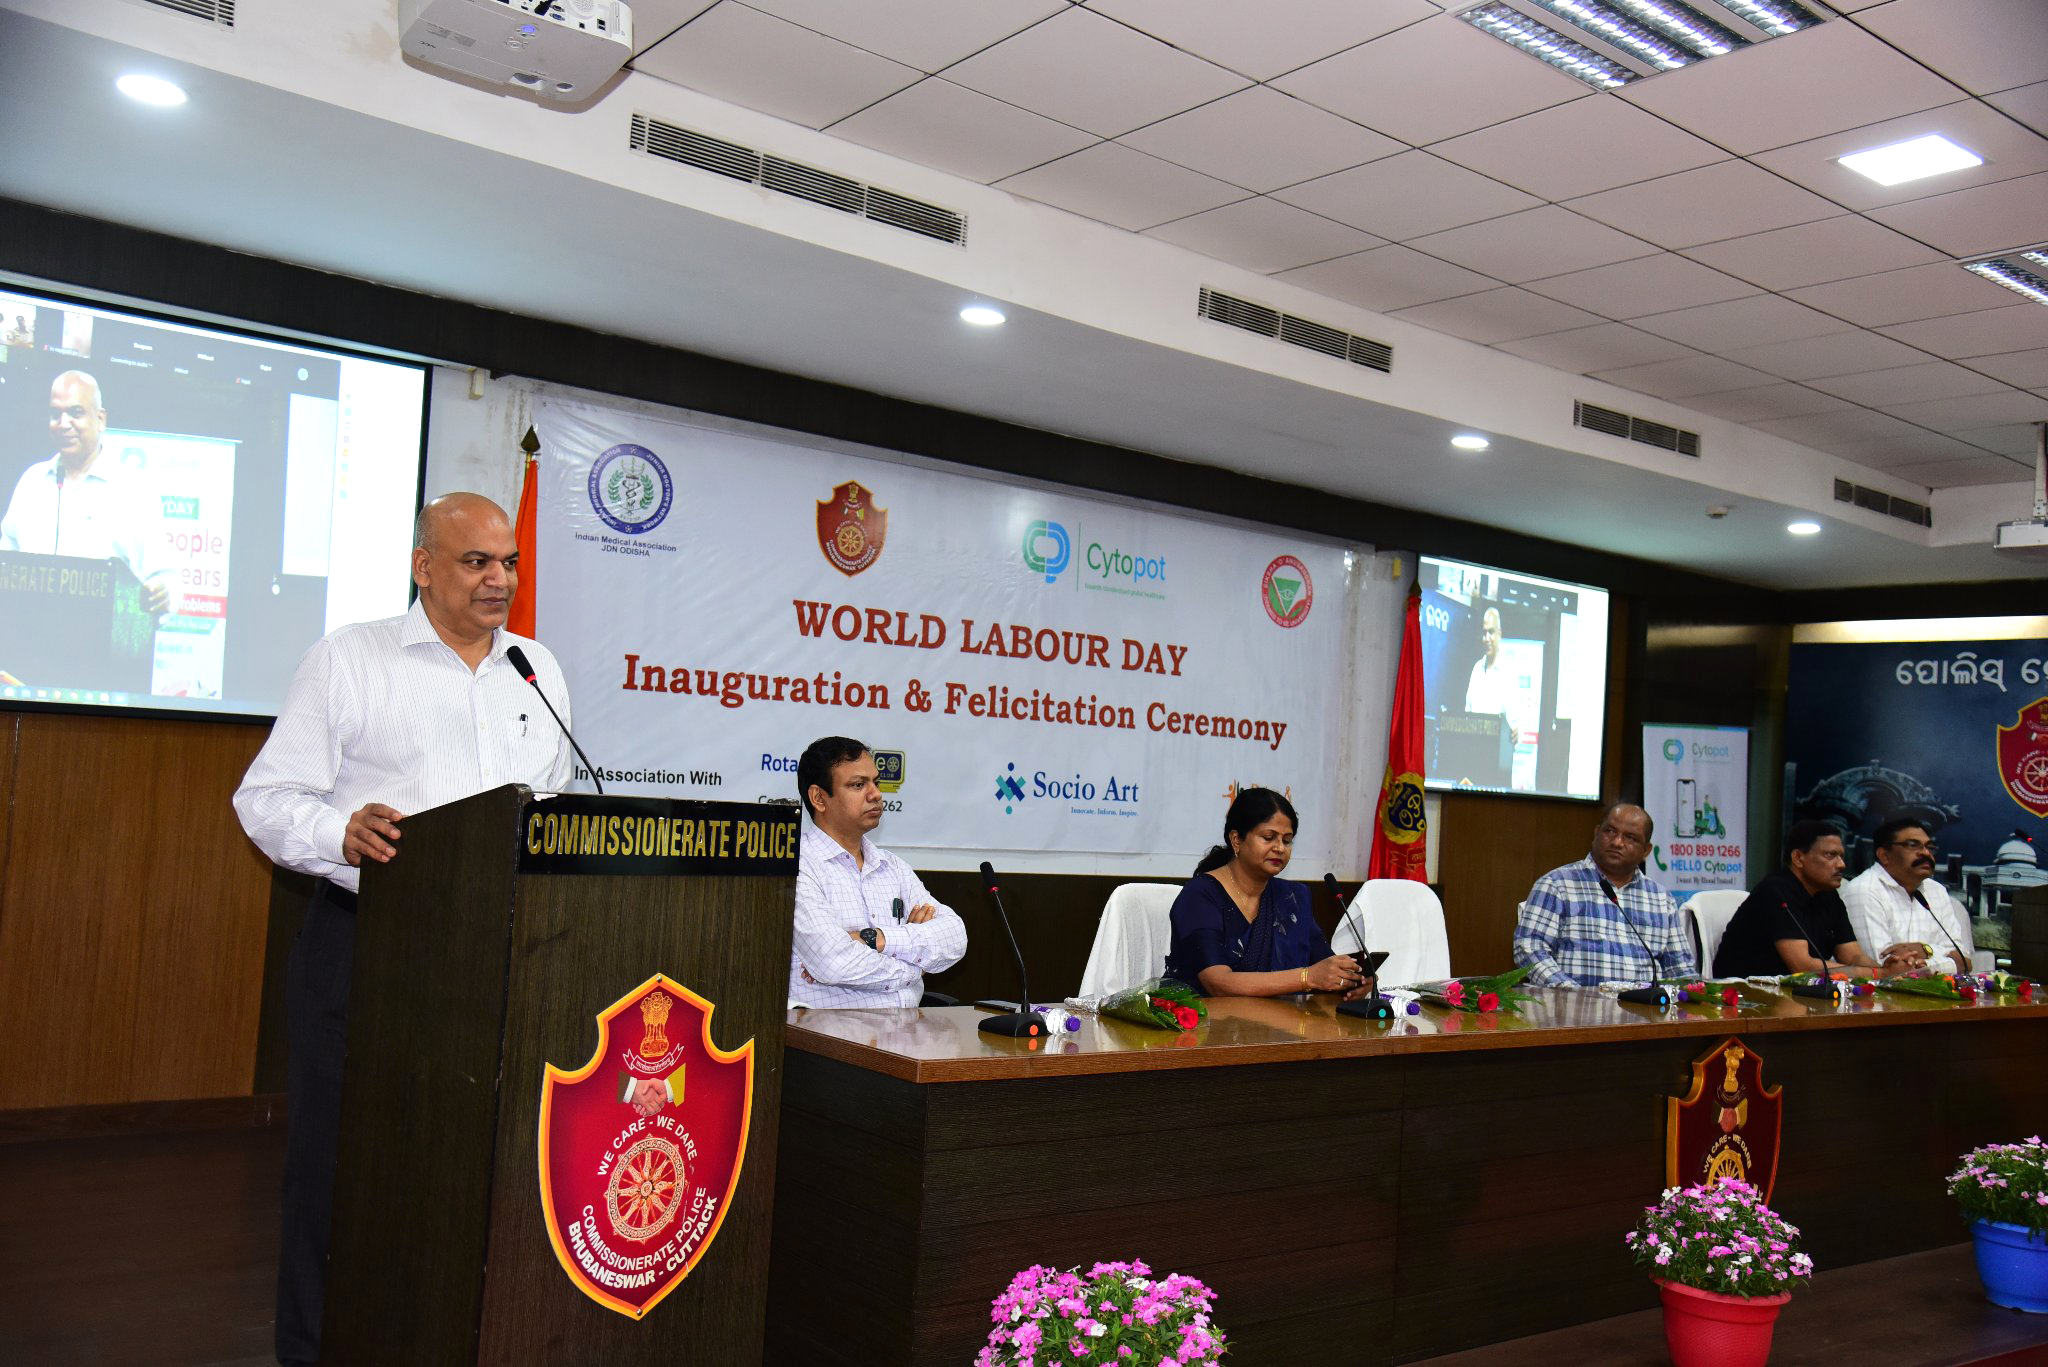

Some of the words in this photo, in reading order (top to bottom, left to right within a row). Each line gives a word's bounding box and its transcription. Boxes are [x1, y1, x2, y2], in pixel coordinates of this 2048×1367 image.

[166, 528, 223, 559] eople
[575, 532, 599, 542] Indian
[601, 536, 631, 547] Medical
[633, 540, 677, 552] Association
[601, 544, 618, 553] JDN
[620, 547, 650, 557] ODISHA
[1087, 543, 1166, 583] Cytopot
[60, 568, 109, 597] POLICE
[181, 568, 221, 588] ears
[792, 600, 946, 649] WORLD
[960, 619, 1110, 668] LABOUR
[1121, 638, 1188, 677] DAY
[623, 654, 890, 709] Inauguration
[904, 678, 933, 713] &
[944, 682, 1135, 729] Felicitation
[1146, 702, 1287, 751] Ceremony
[1692, 742, 1729, 758] Cytopot
[575, 765, 589, 781] In
[595, 766, 685, 785] Association
[690, 770, 722, 786] With
[761, 753, 799, 773] Rota
[1033, 771, 1096, 801] Socio
[1102, 776, 1138, 803] Art
[882, 800, 903, 813] 262
[527, 813, 731, 858] COMMISSIONERATE
[735, 821, 797, 859] POLICE
[1670, 844, 1693, 857] 1800
[1695, 844, 1715, 857] 889
[1717, 845, 1741, 858] 1266
[1670, 860, 1702, 872] HELLO
[1704, 860, 1743, 875] Cytopot
[597, 1150, 615, 1175] WE
[613, 1118, 646, 1149] CARE
[656, 1115, 676, 1131] WE
[675, 1124, 698, 1161] DARE
[1711, 1134, 1727, 1154] CARE
[582, 1204, 676, 1271] COMMISSIONERATE
[675, 1186, 707, 1243] POLICE
[568, 1221, 656, 1289] BHUBANESWAR
[666, 1196, 718, 1272] CUTTACK
